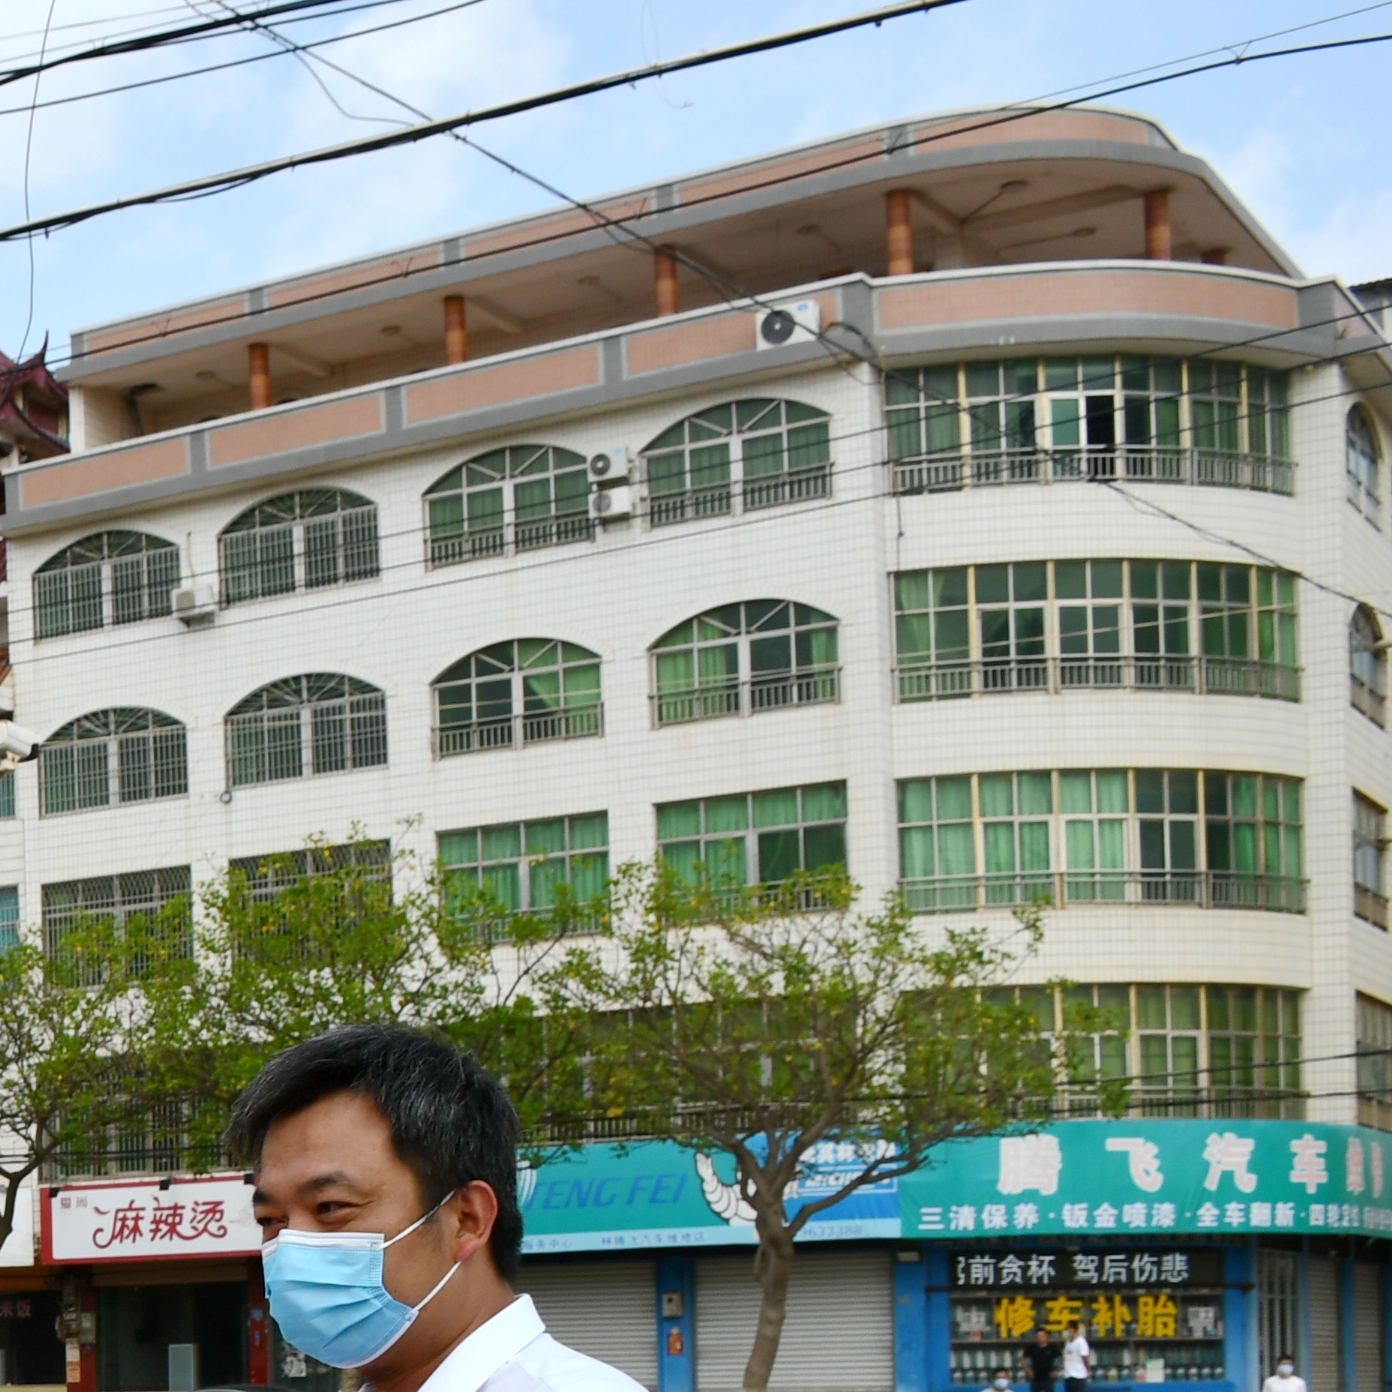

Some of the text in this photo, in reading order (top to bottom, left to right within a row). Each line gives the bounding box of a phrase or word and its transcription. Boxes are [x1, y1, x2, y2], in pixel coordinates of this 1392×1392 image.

[525, 1173, 688, 1211] TENG FEI
[92, 1194, 228, 1249] 麻辣烫
[1072, 1253, 1190, 1285] 驾后伤悲
[993, 1293, 1179, 1339] 修车补胎
